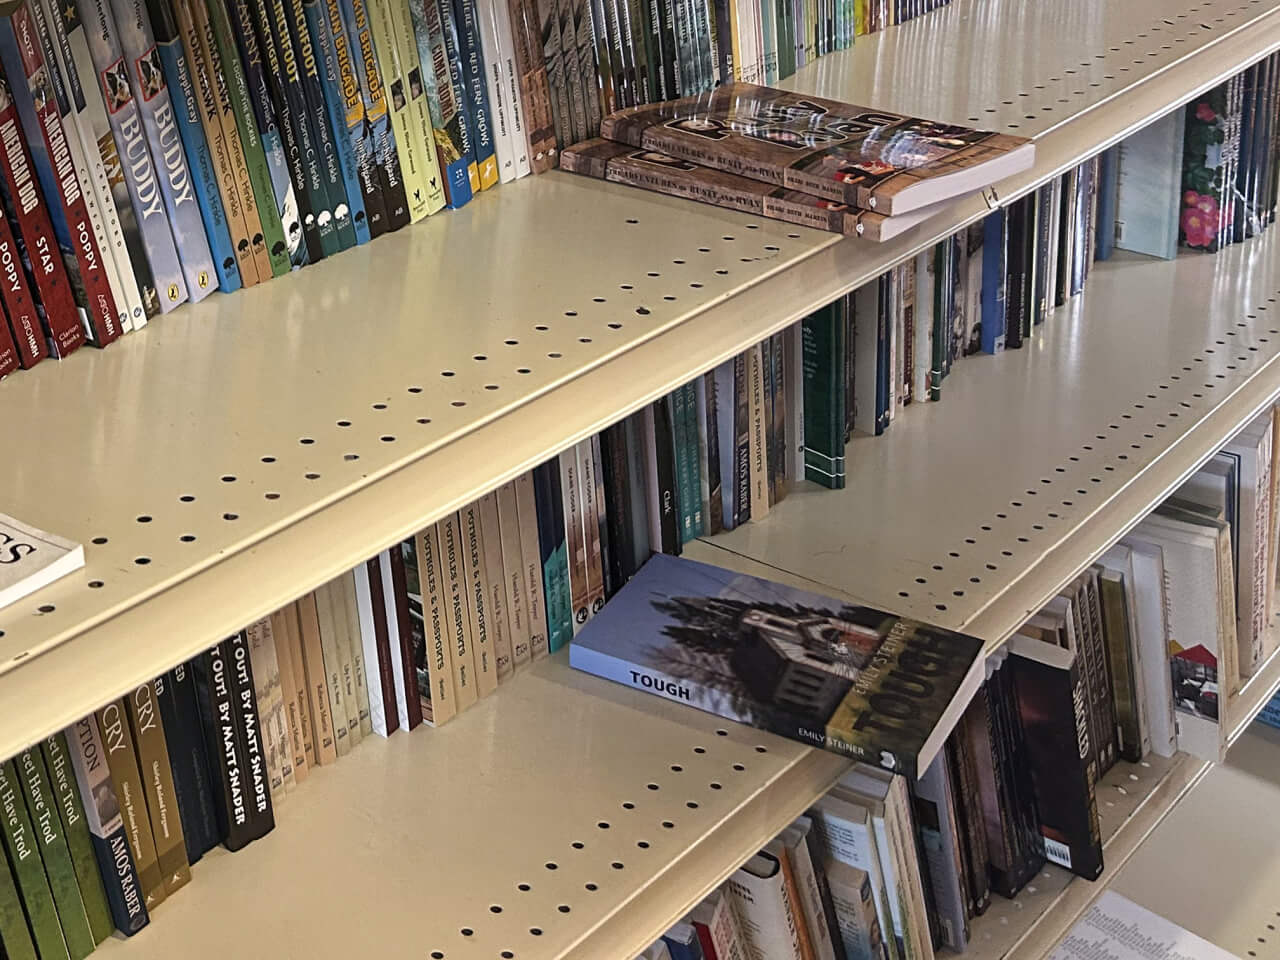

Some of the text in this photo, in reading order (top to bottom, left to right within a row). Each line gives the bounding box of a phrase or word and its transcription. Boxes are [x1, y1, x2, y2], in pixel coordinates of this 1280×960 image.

[333, 35, 357, 109] BRIGADE
[471, 76, 482, 105] FERN
[477, 109, 488, 146] GROWS
[120, 113, 162, 219] BUDDY
[424, 533, 436, 593] POTHOLES
[431, 608, 444, 671] PASSPORTS
[629, 670, 692, 702] TOUGH
[213, 659, 245, 824] OUT! BY MATT SNADER
[798, 728, 864, 756] EMILY STEINER
[2, 787, 30, 860] Have Trod
[111, 836, 127, 876] AMOS
[122, 875, 142, 918] RABER
